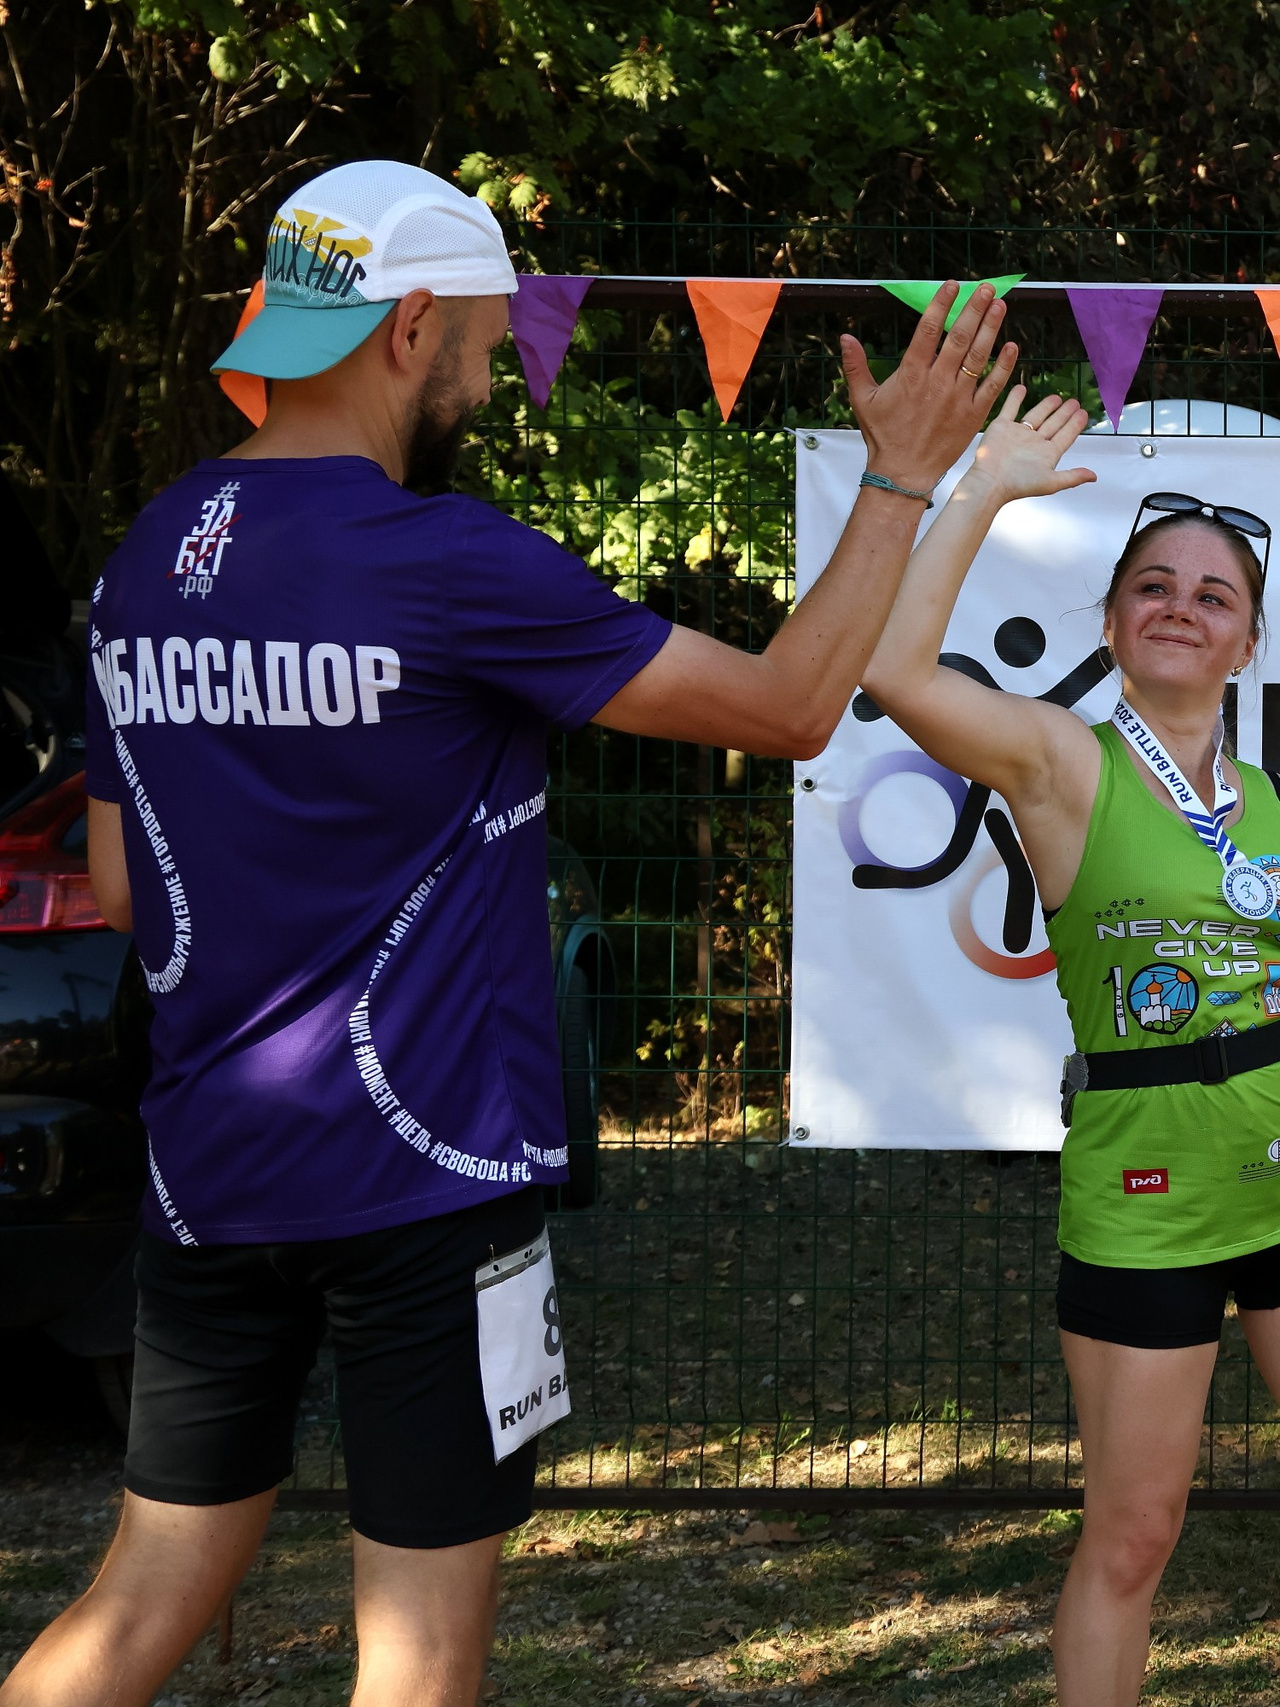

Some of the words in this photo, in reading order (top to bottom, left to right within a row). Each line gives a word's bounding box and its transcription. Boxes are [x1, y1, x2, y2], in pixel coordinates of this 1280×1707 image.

[1127, 722, 1171, 772] BATTLE
[1164, 771, 1193, 804] RUN
[134, 784, 176, 874] #ГОРДОСТЬ
[1096, 919, 1261, 940] NEVER
[1153, 939, 1258, 957] GIVE
[1202, 960, 1260, 977] UP
[353, 1044, 401, 1115] #МОМЕНТ
[388, 1108, 432, 1154] #ЦЕЛЬ
[428, 1141, 509, 1182] #СВОБОДА
[499, 1386, 543, 1431] RUN
